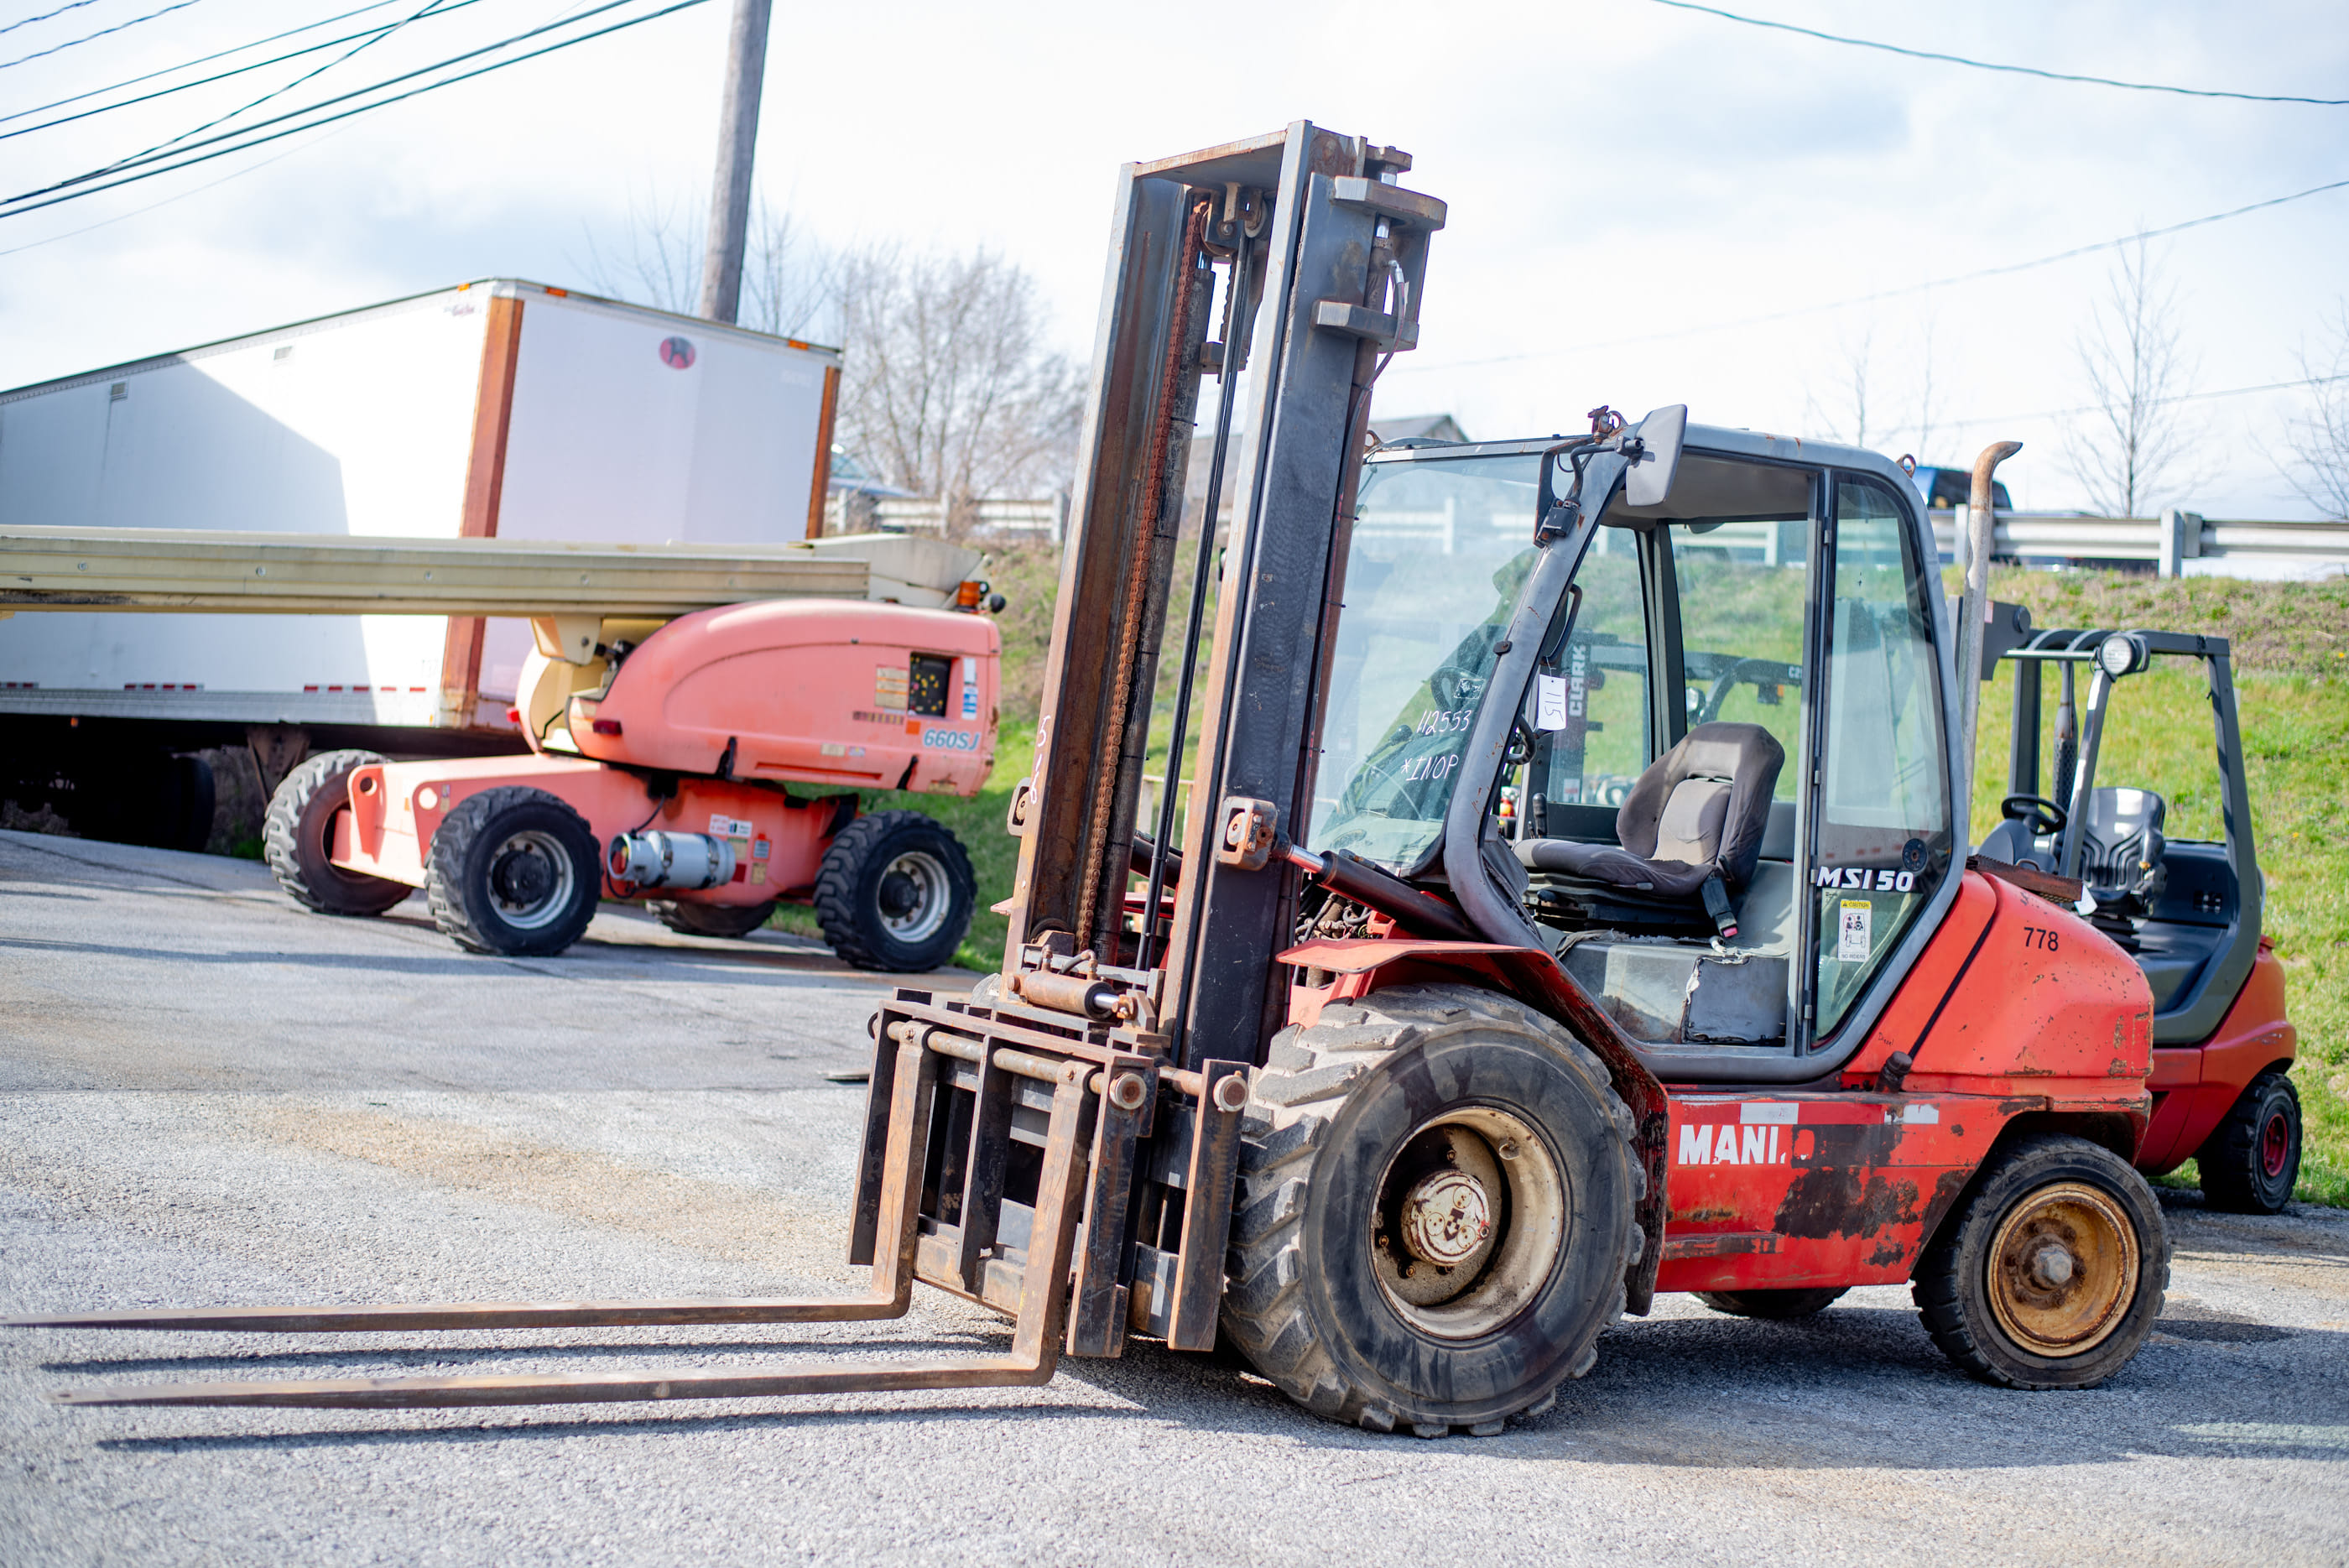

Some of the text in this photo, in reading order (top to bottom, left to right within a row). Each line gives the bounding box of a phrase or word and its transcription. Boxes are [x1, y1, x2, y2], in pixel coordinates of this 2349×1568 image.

[1569, 644, 1586, 716] CLARK
[1789, 665, 1803, 679] C2
[1416, 709, 1472, 736] 112553
[924, 729, 980, 751] 660SJ
[2023, 926, 2059, 951] 778
